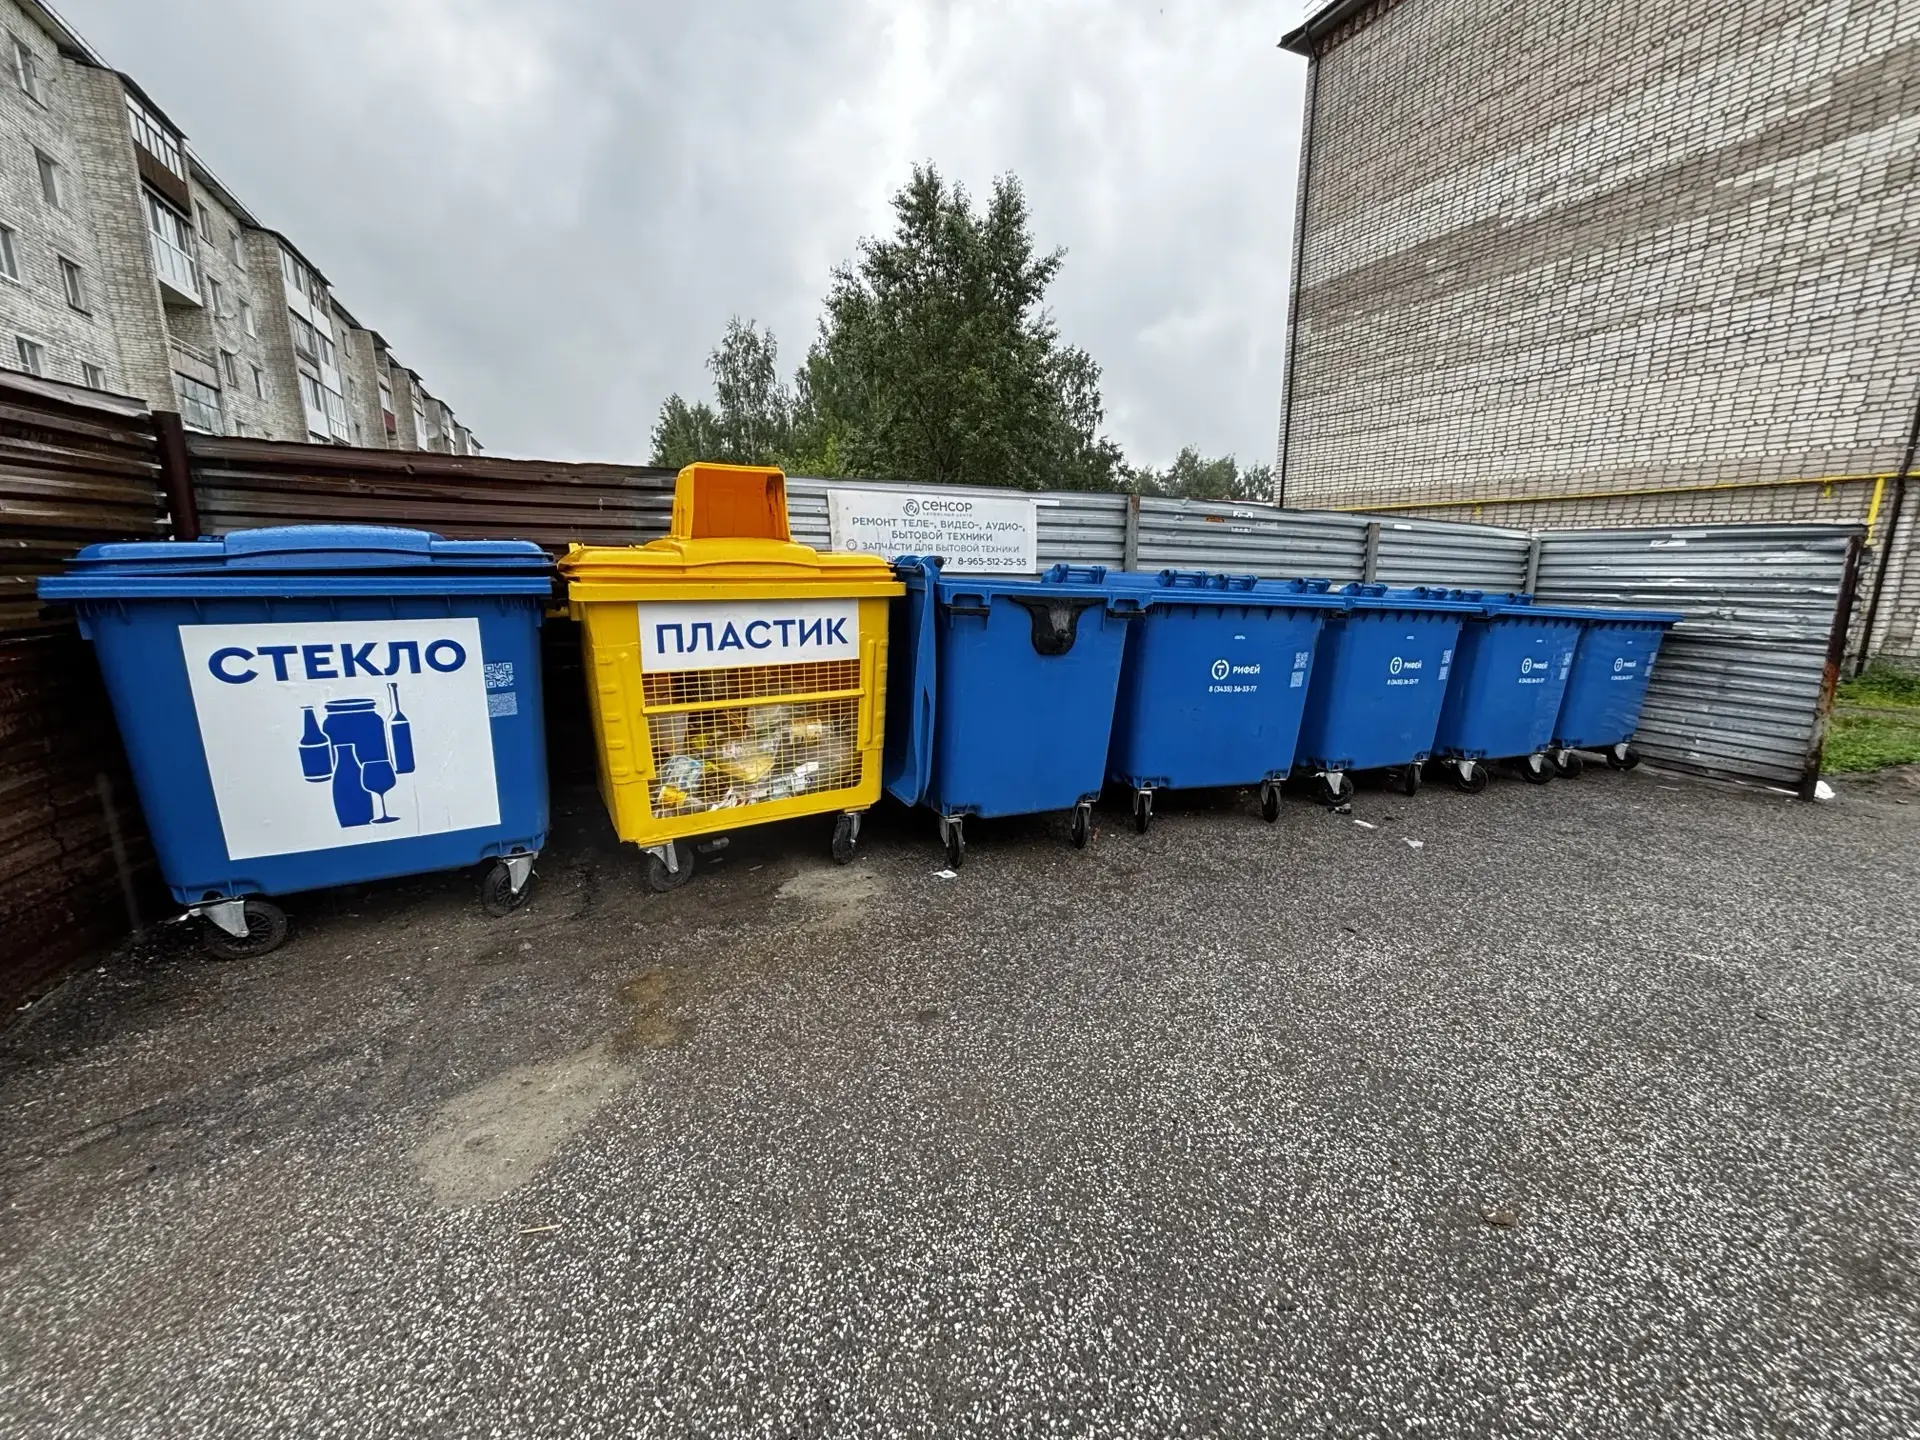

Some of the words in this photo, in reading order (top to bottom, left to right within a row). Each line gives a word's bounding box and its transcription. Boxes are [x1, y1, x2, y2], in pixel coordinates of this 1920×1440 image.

[852, 517, 898, 527] РЕМОНТ
[902, 519, 937, 529] ТЕЛЕ-,
[940, 520, 983, 531] ВИДЕО-,
[985, 521, 1026, 532] АУДИО-,
[892, 529, 943, 540] БЫТОВОЙ
[946, 531, 993, 542] ТЕХНИКИ
[862, 541, 912, 551] ЗАПЧАСТИ
[914, 543, 934, 552] ДЛЯ
[935, 543, 980, 553] БЫТОВОЙ
[982, 545, 1020, 553] ТЕХНИКИ
[957, 556, 1027, 566] 8-965-512-25-55
[656, 617, 849, 654] ПЛАСТИК
[208, 639, 467, 684] СТЕКЛО
[1232, 664, 1261, 674] РИФЕЙ
[1233, 685, 1257, 693] 36-33-77
